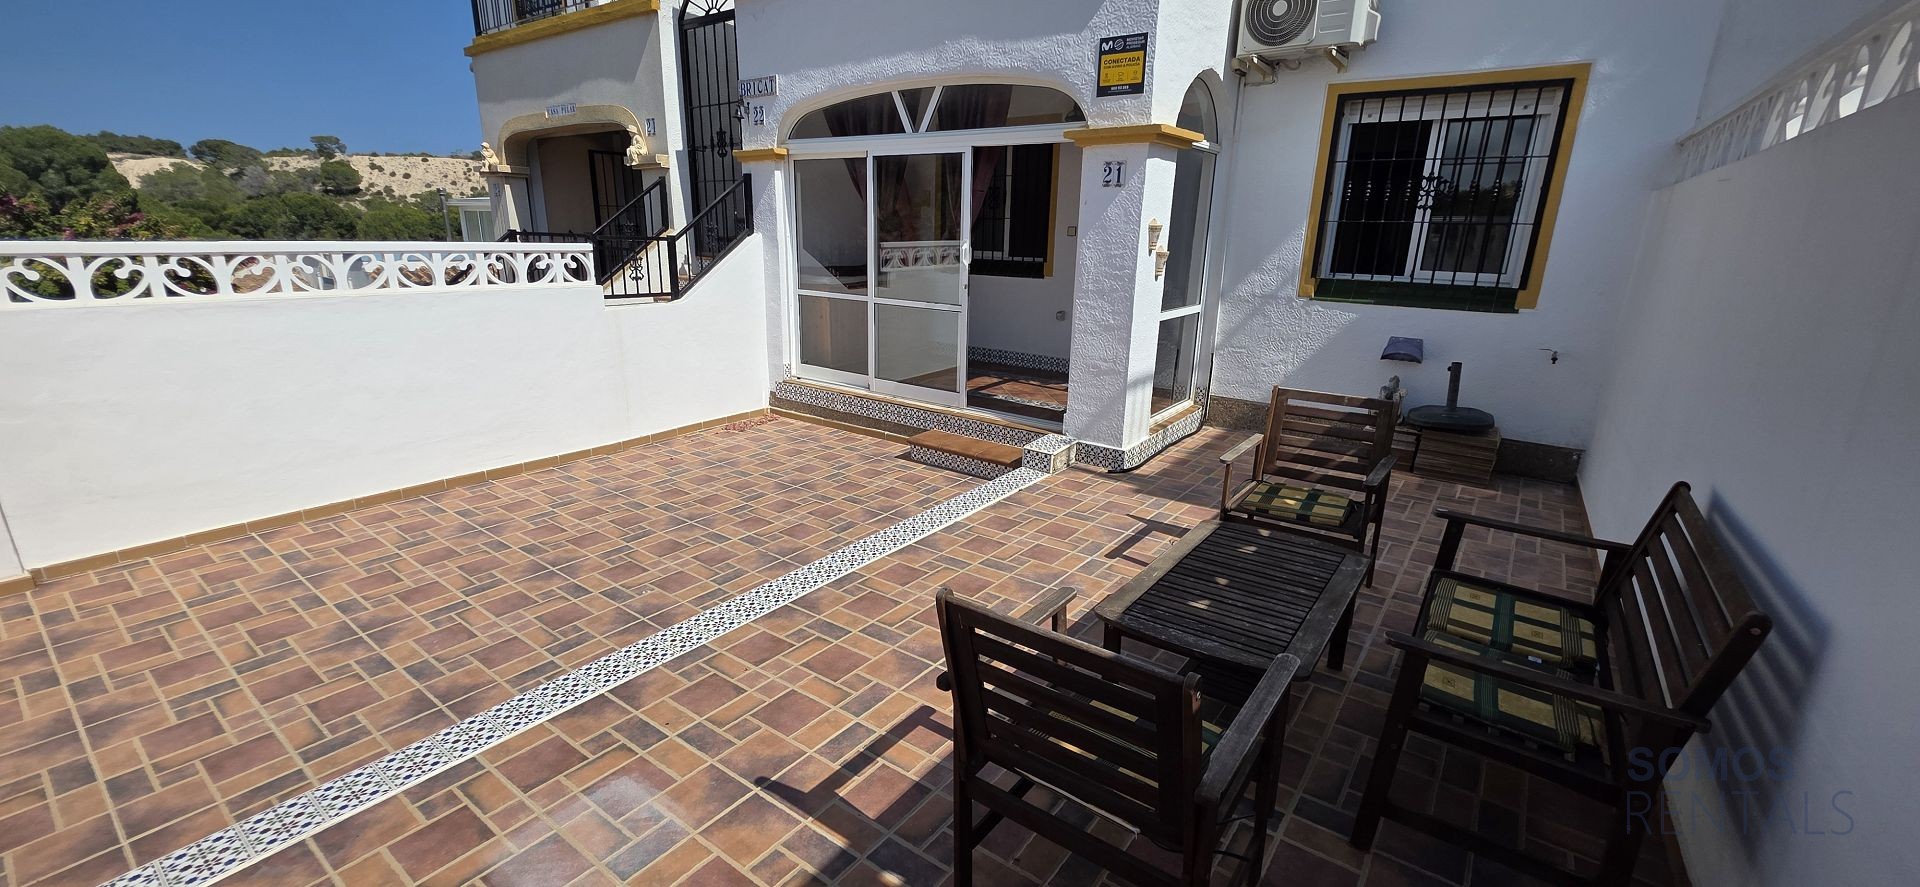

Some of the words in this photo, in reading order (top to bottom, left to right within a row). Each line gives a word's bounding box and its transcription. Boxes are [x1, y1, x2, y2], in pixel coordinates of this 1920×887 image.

[1103, 56, 1141, 65] CONECTADA
[740, 79, 774, 96] BRICAT
[753, 109, 764, 122] 22
[1103, 165, 1121, 183] 21
